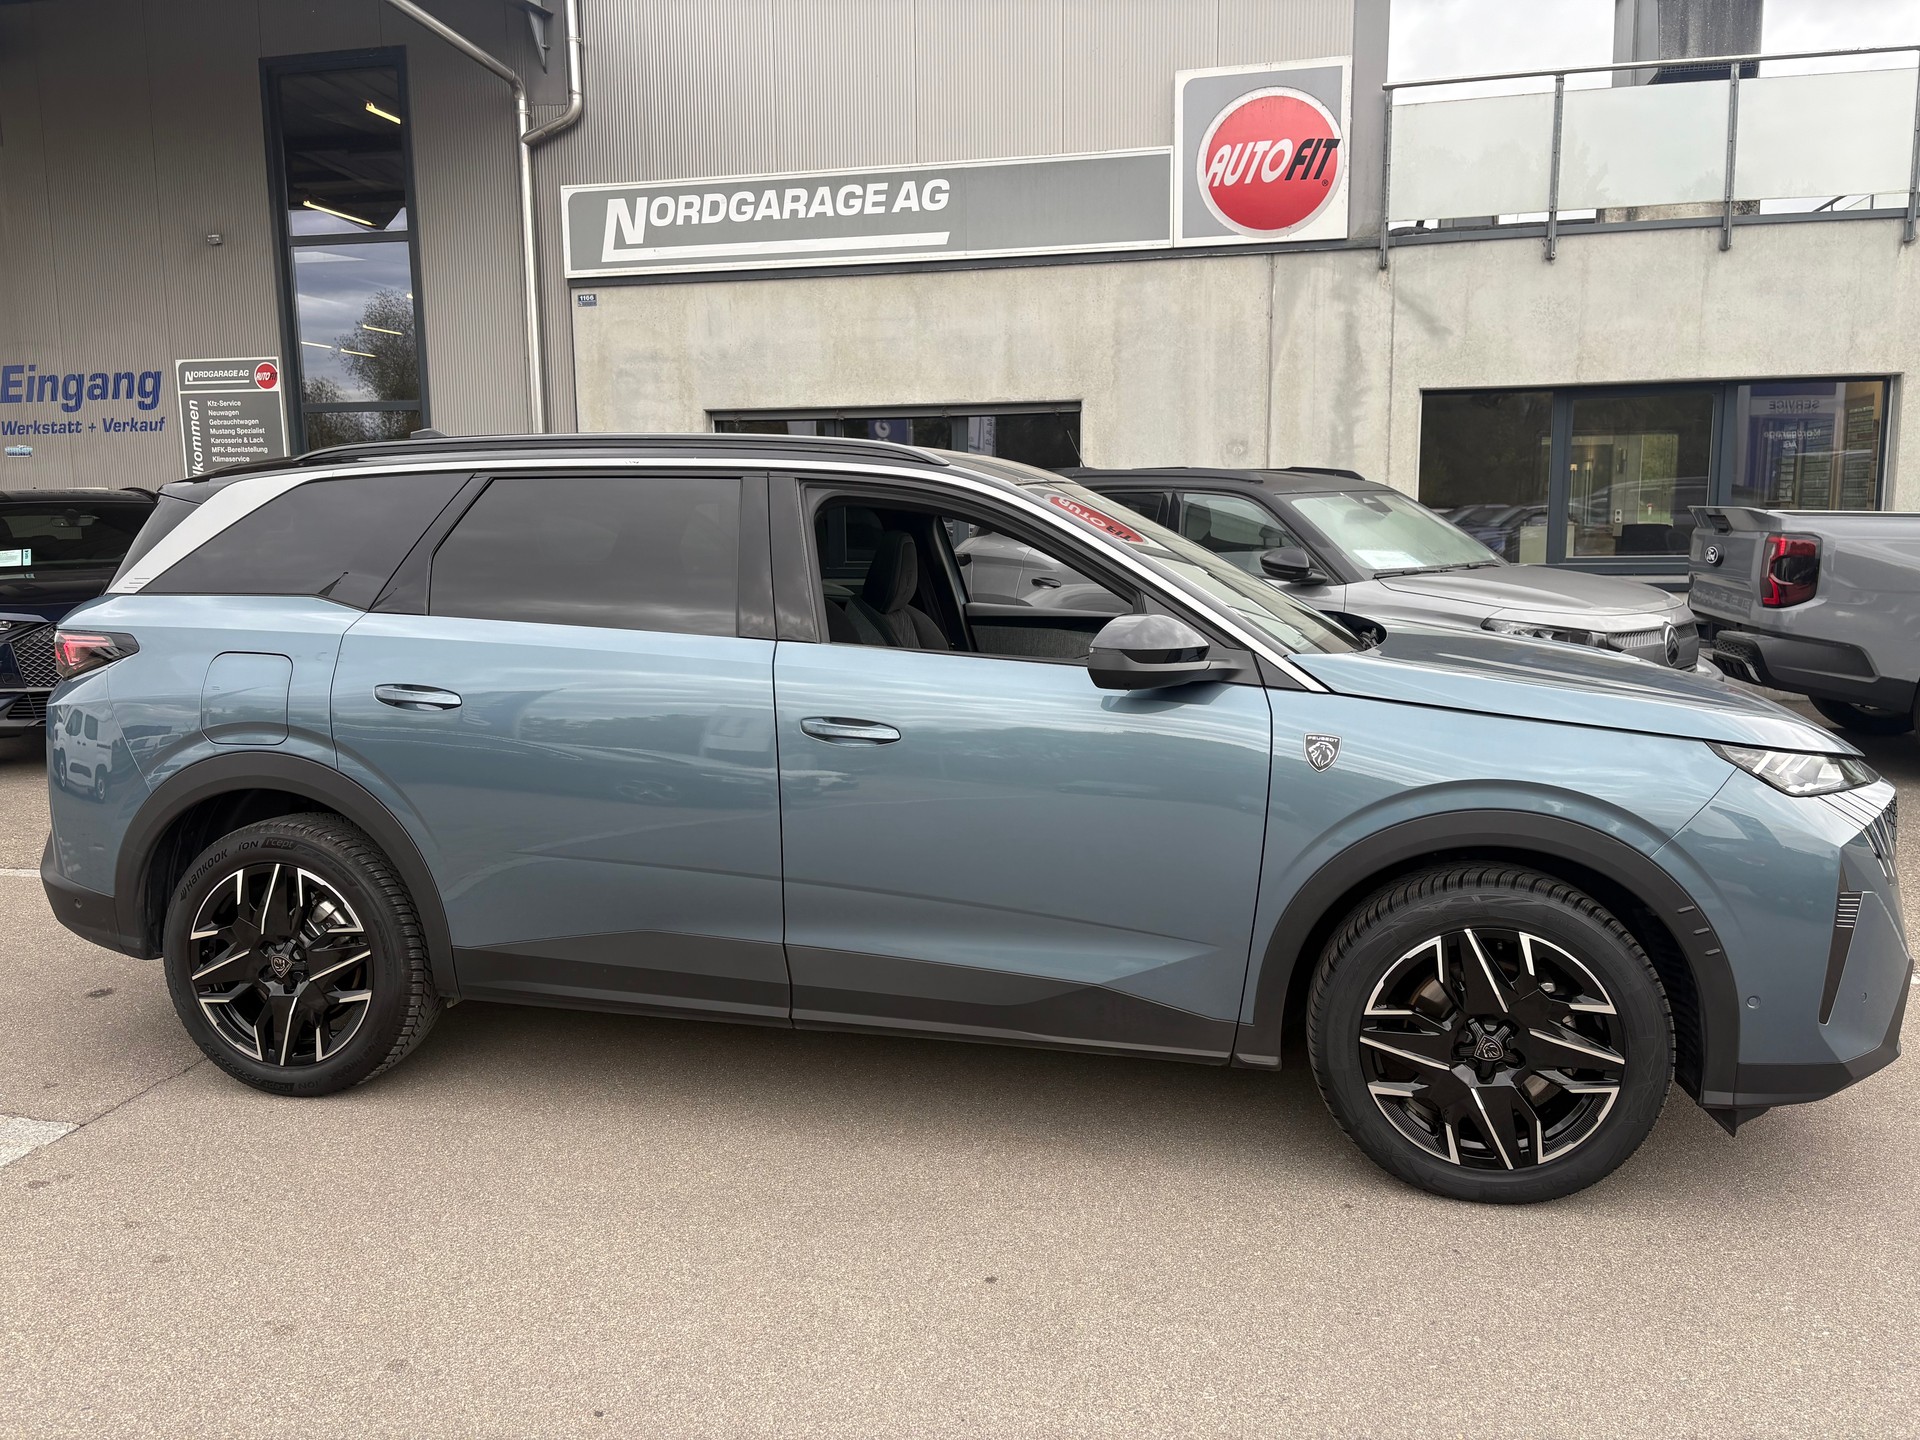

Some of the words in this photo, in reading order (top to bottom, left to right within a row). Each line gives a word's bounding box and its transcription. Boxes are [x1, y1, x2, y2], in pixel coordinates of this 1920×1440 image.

[1206, 138, 1341, 187] AUTOFIT
[602, 182, 888, 246] NORDGARAGE
[891, 178, 950, 213] AG
[185, 369, 238, 382] NORDGARAGE
[239, 369, 250, 377] AG
[0, 364, 162, 413] Eingang
[207, 399, 241, 407] Kfz-Service
[208, 409, 240, 417] Neuwagen
[1, 418, 82, 436] Werkstatt
[88, 423, 97, 433] +
[102, 416, 166, 433] Verkauf
[209, 418, 259, 426] Gebrauchtwagen
[210, 428, 236, 436] Mustang
[236, 427, 265, 435] Spezialist
[189, 399, 204, 476] lkommen
[249, 436, 264, 444] Lack
[212, 455, 250, 463] Klimaservice
